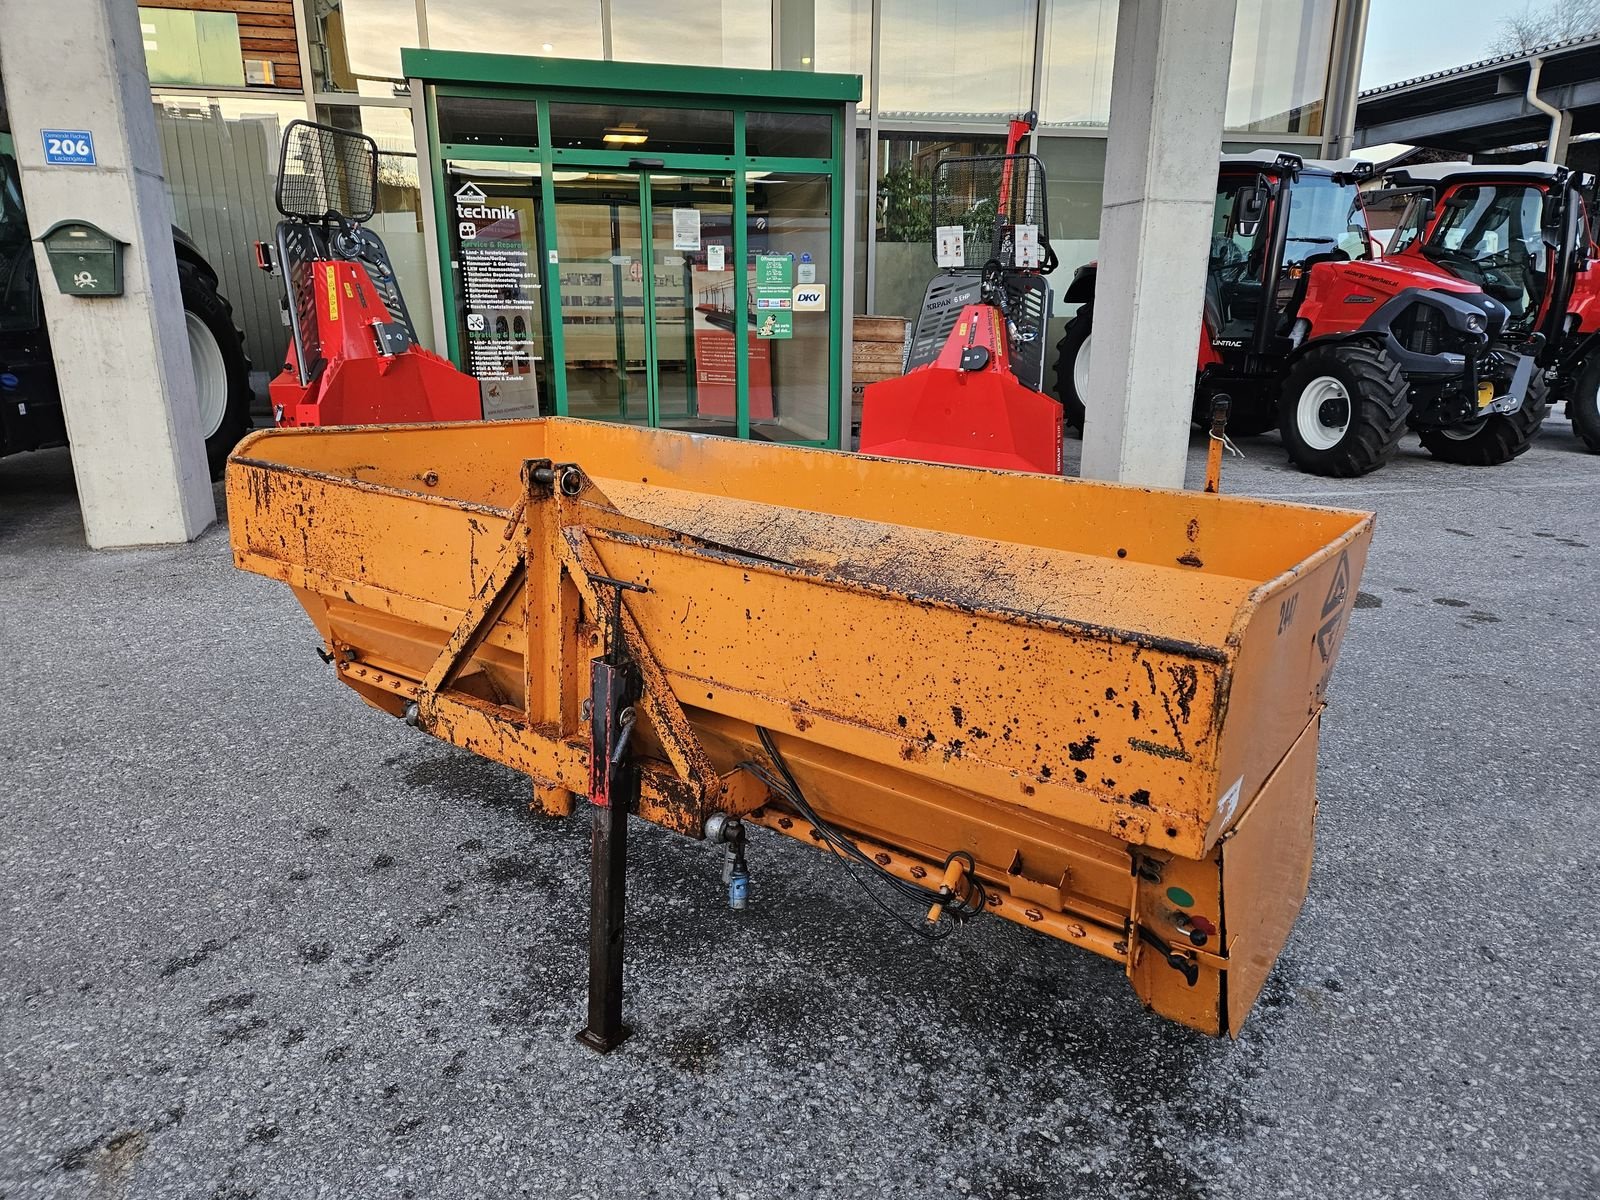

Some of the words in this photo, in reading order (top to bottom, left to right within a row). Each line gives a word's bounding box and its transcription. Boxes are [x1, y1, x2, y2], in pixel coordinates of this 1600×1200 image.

[48, 139, 90, 156] 206
[456, 204, 515, 220] technik
[797, 294, 820, 302] DKV
[926, 299, 951, 310] KRPAN
